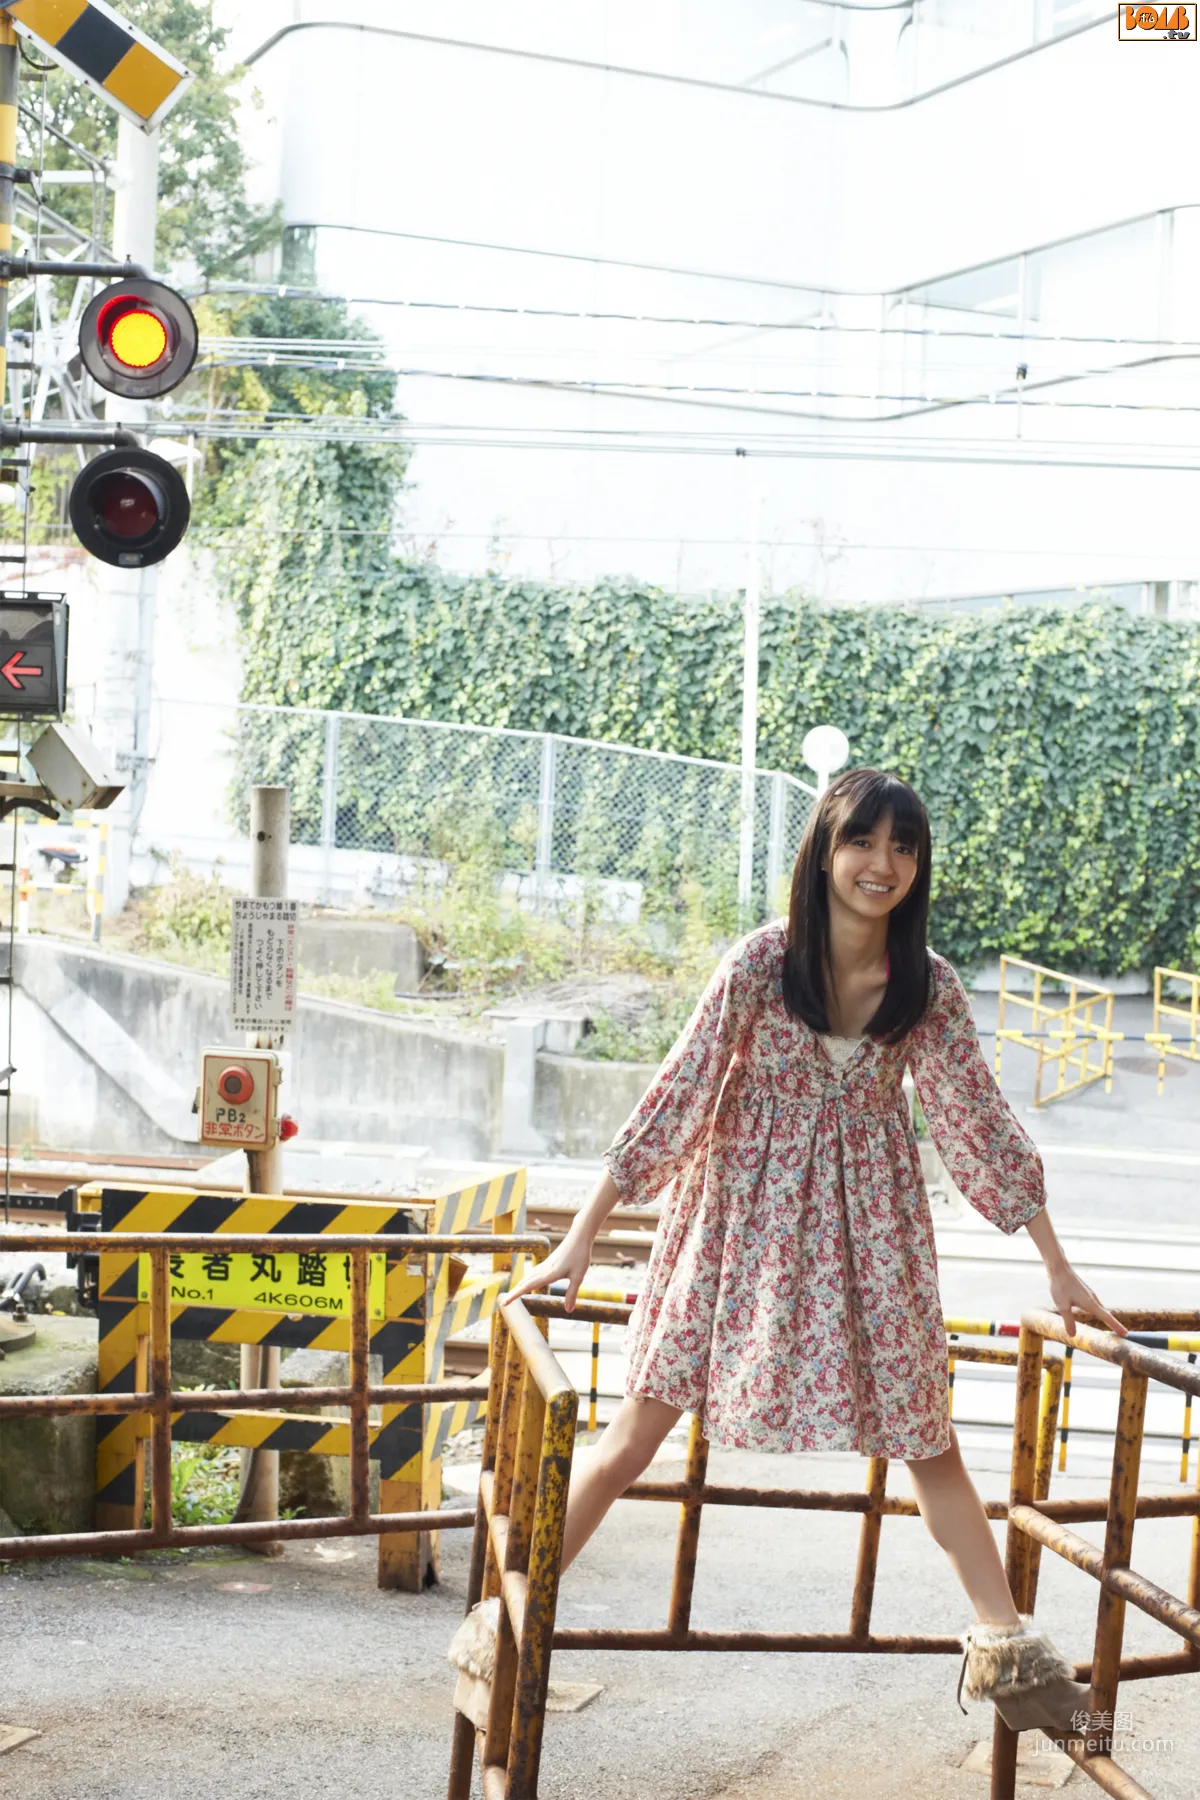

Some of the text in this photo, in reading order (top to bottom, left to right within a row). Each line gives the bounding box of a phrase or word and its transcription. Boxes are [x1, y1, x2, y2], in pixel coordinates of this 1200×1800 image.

[275, 938, 285, 988] 下のボタンを
[215, 1108, 246, 1123] PB2
[204, 1121, 265, 1139] 非常ボタン
[171, 1286, 343, 1310] No.1 4K606M
